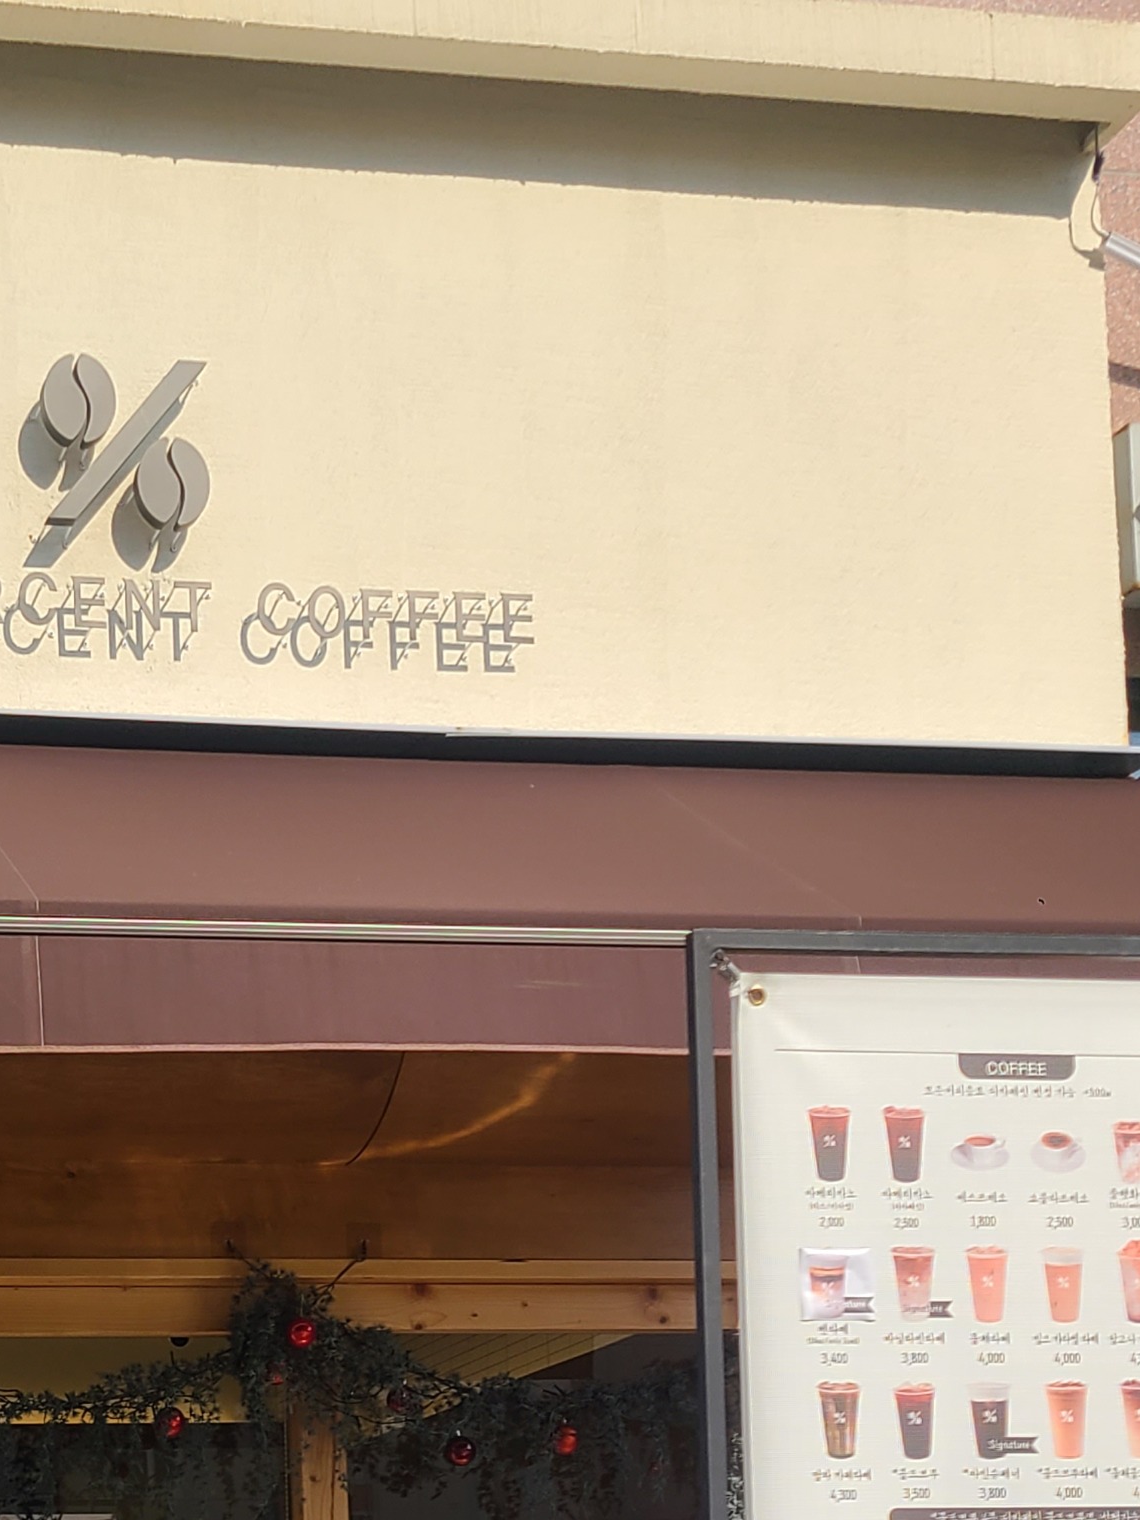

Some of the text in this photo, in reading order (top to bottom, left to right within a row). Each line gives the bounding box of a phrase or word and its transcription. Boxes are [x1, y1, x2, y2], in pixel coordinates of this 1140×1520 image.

[257, 582, 535, 645] COFFEE
[986, 1061, 1047, 1077] COFFEE
[977, 1352, 1006, 1366] 4,000
[1054, 1352, 1082, 1366] 4,000
[1055, 1487, 1084, 1501] 4,000
